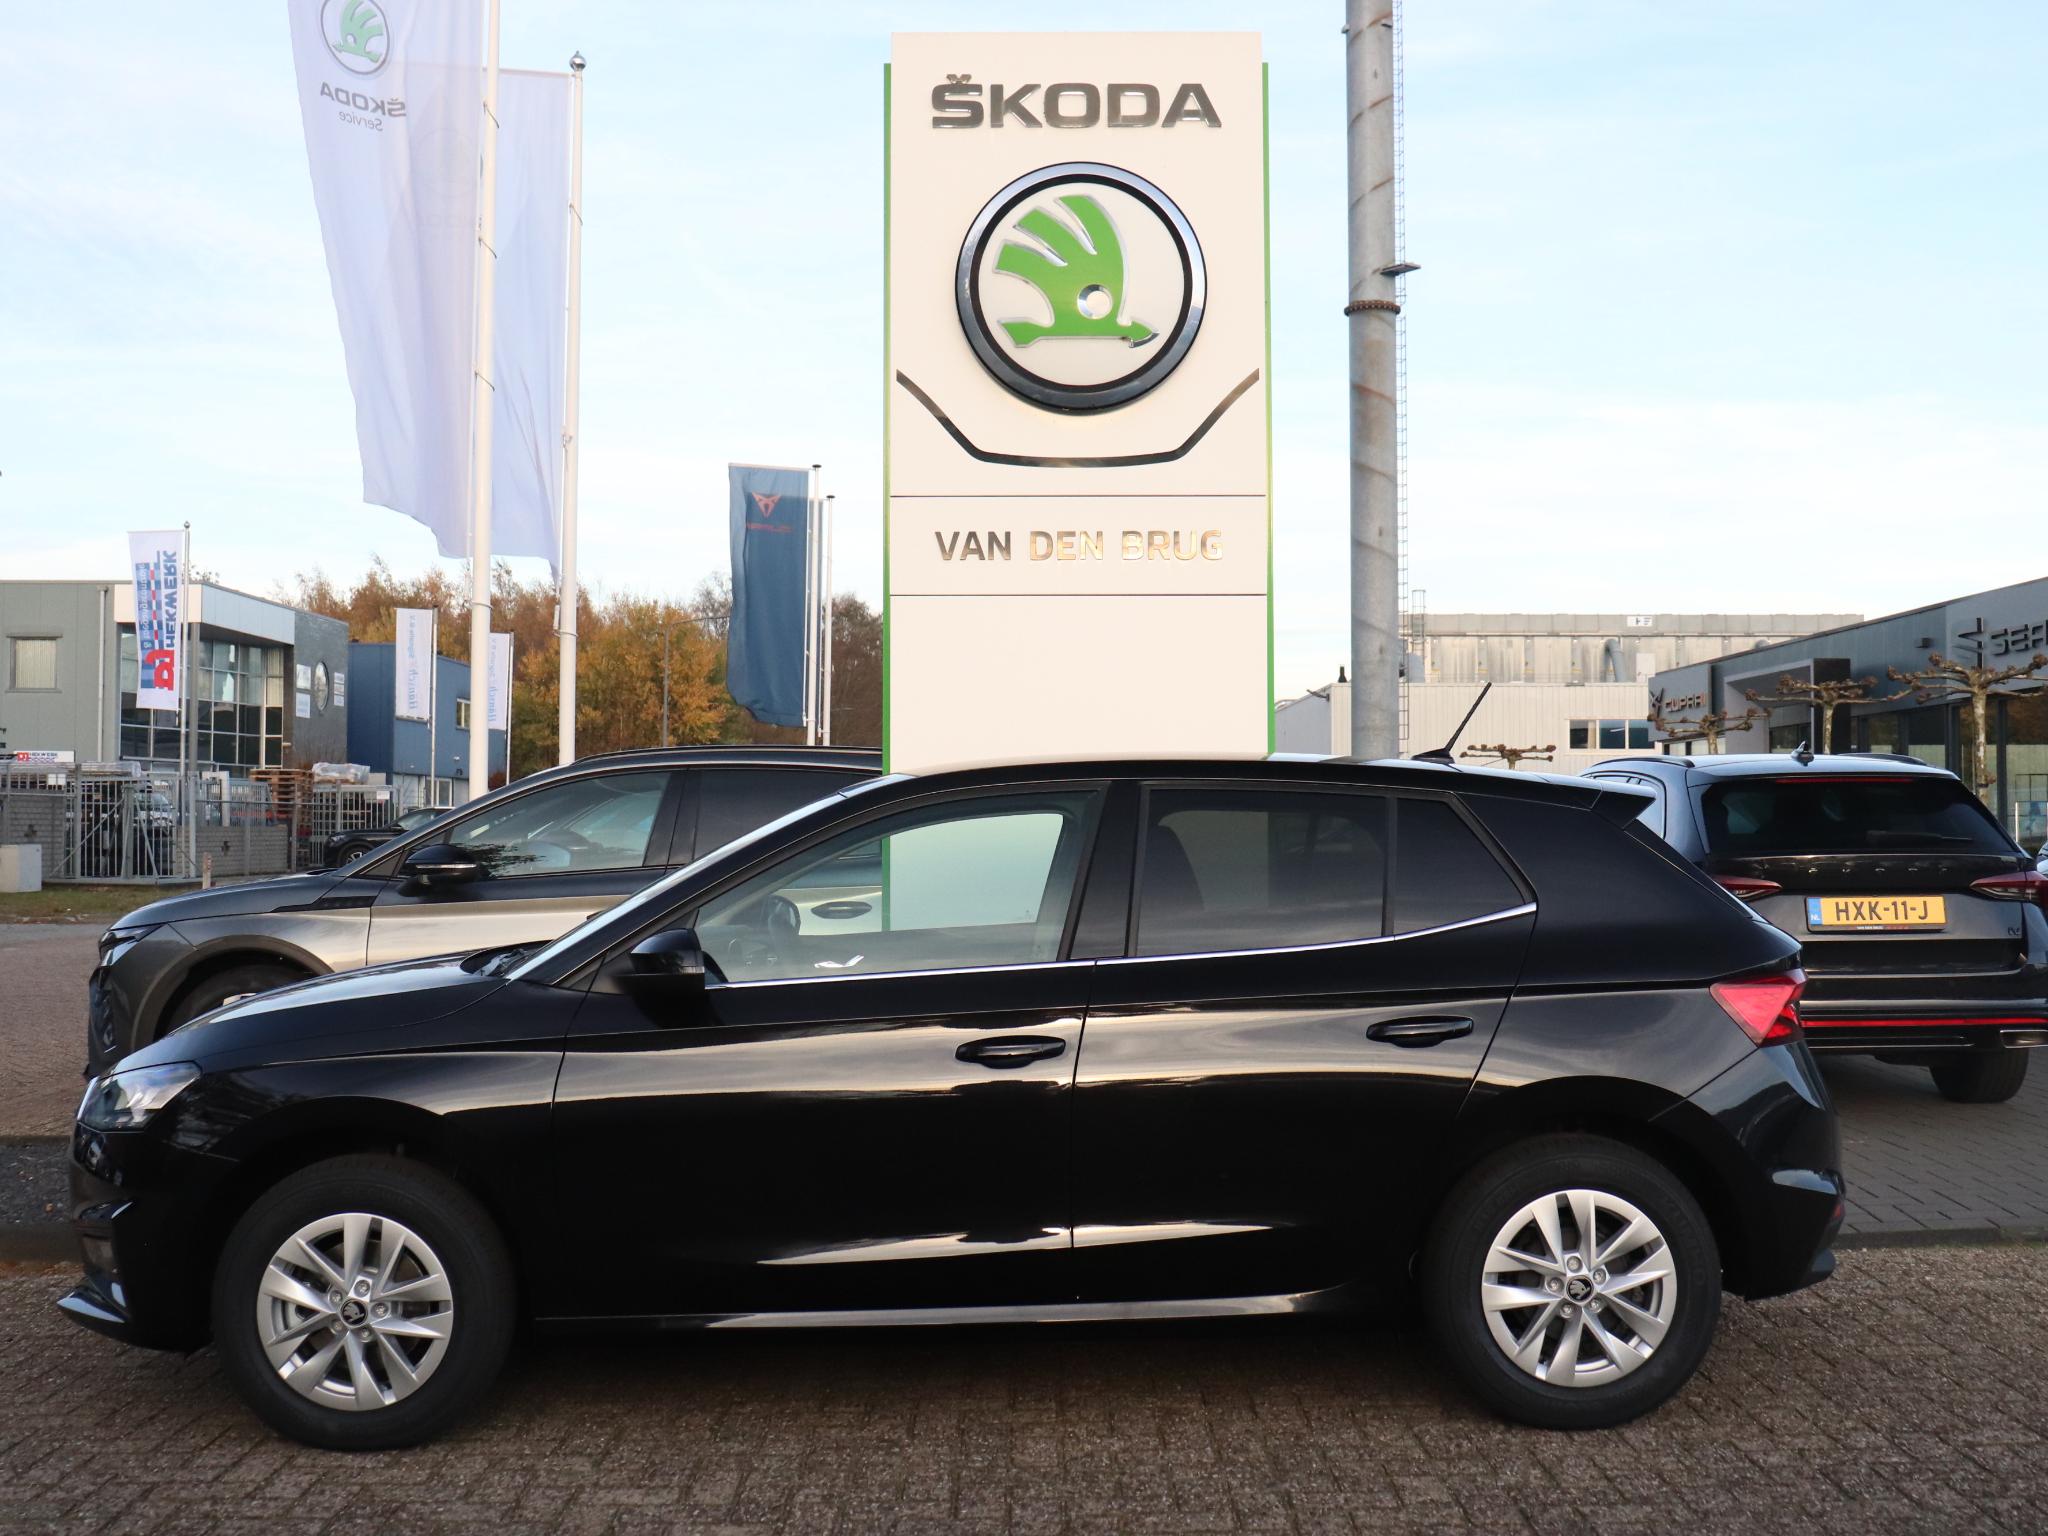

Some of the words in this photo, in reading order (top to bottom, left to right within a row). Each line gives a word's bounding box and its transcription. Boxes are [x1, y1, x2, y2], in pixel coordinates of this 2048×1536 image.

[931, 74, 1222, 128] ŠKODA
[934, 531, 1011, 560] VAN
[1029, 531, 1103, 560] DEN
[1122, 531, 1223, 560] BRUG
[1835, 900, 1929, 921] HXK-11-J
